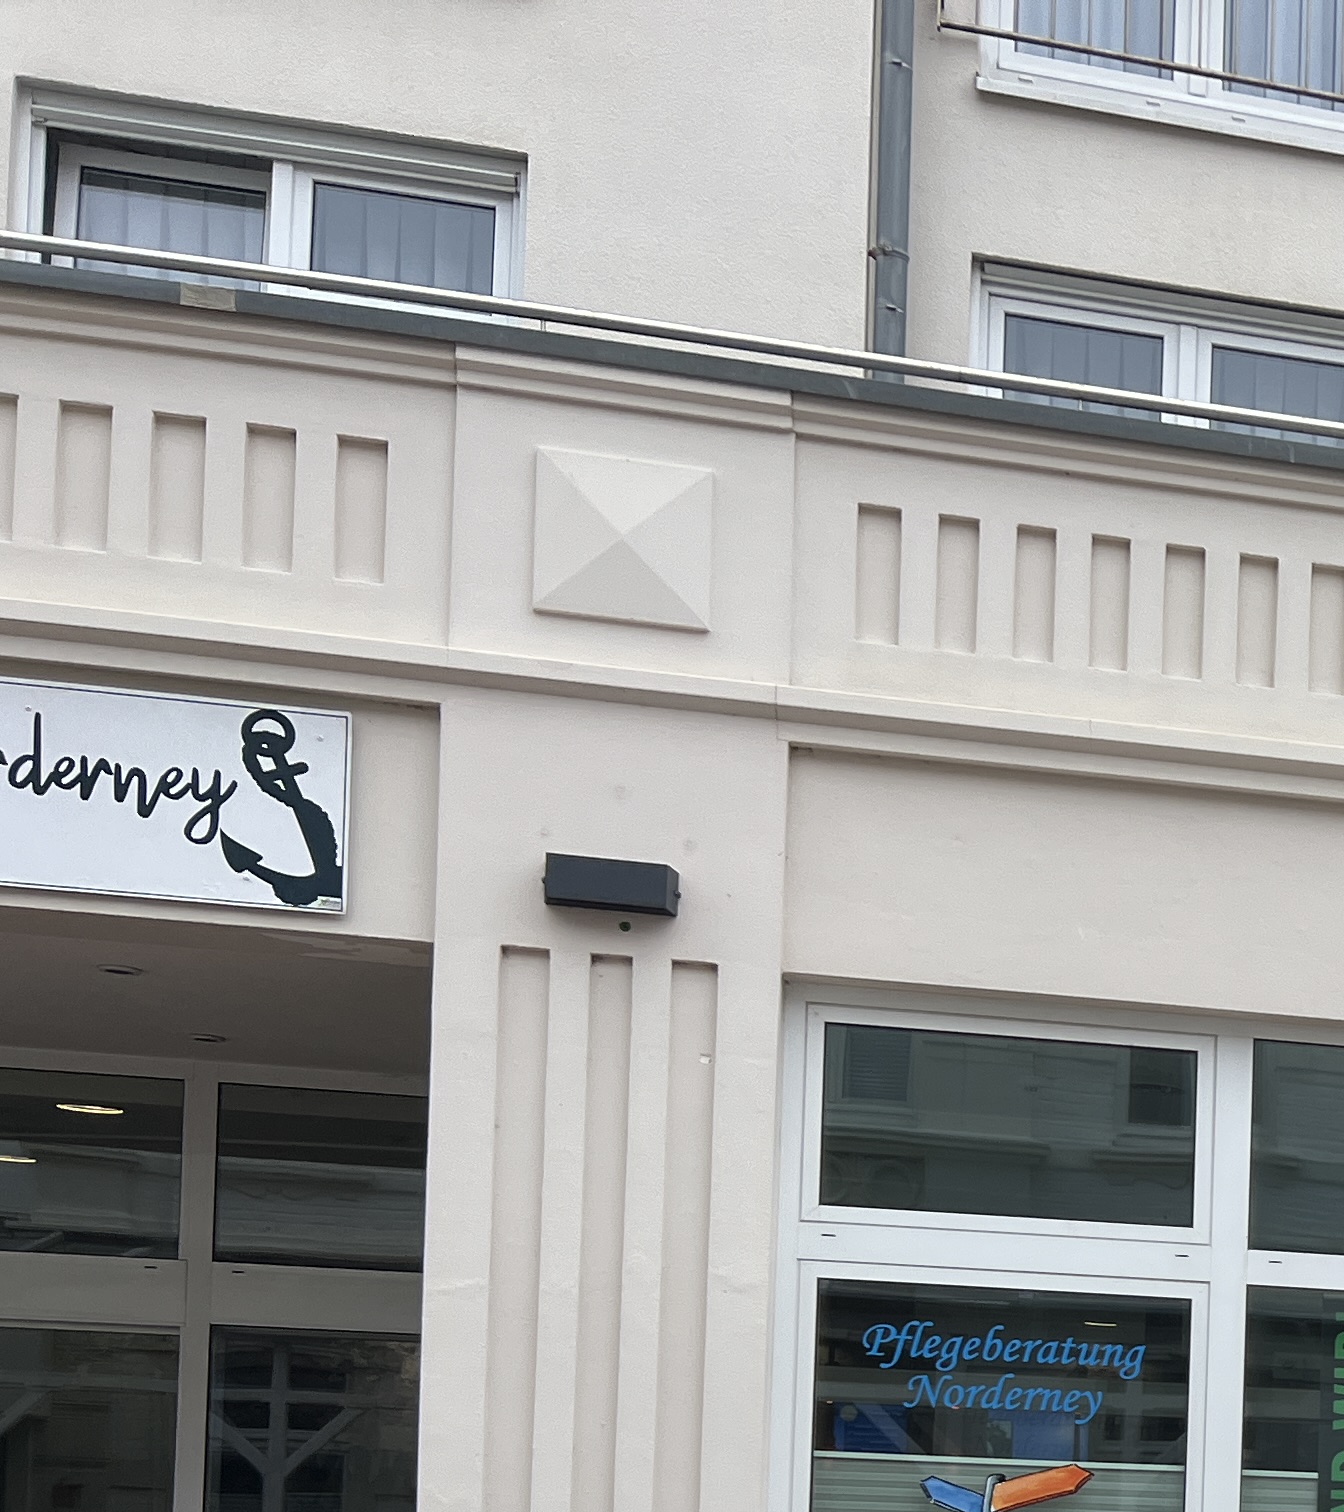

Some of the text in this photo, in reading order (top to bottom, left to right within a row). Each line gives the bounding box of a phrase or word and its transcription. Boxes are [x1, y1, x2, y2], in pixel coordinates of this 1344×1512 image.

[0, 712, 237, 844] derney
[862, 1320, 1146, 1380] Pflegeberatung
[903, 1373, 1103, 1425] Norderney
